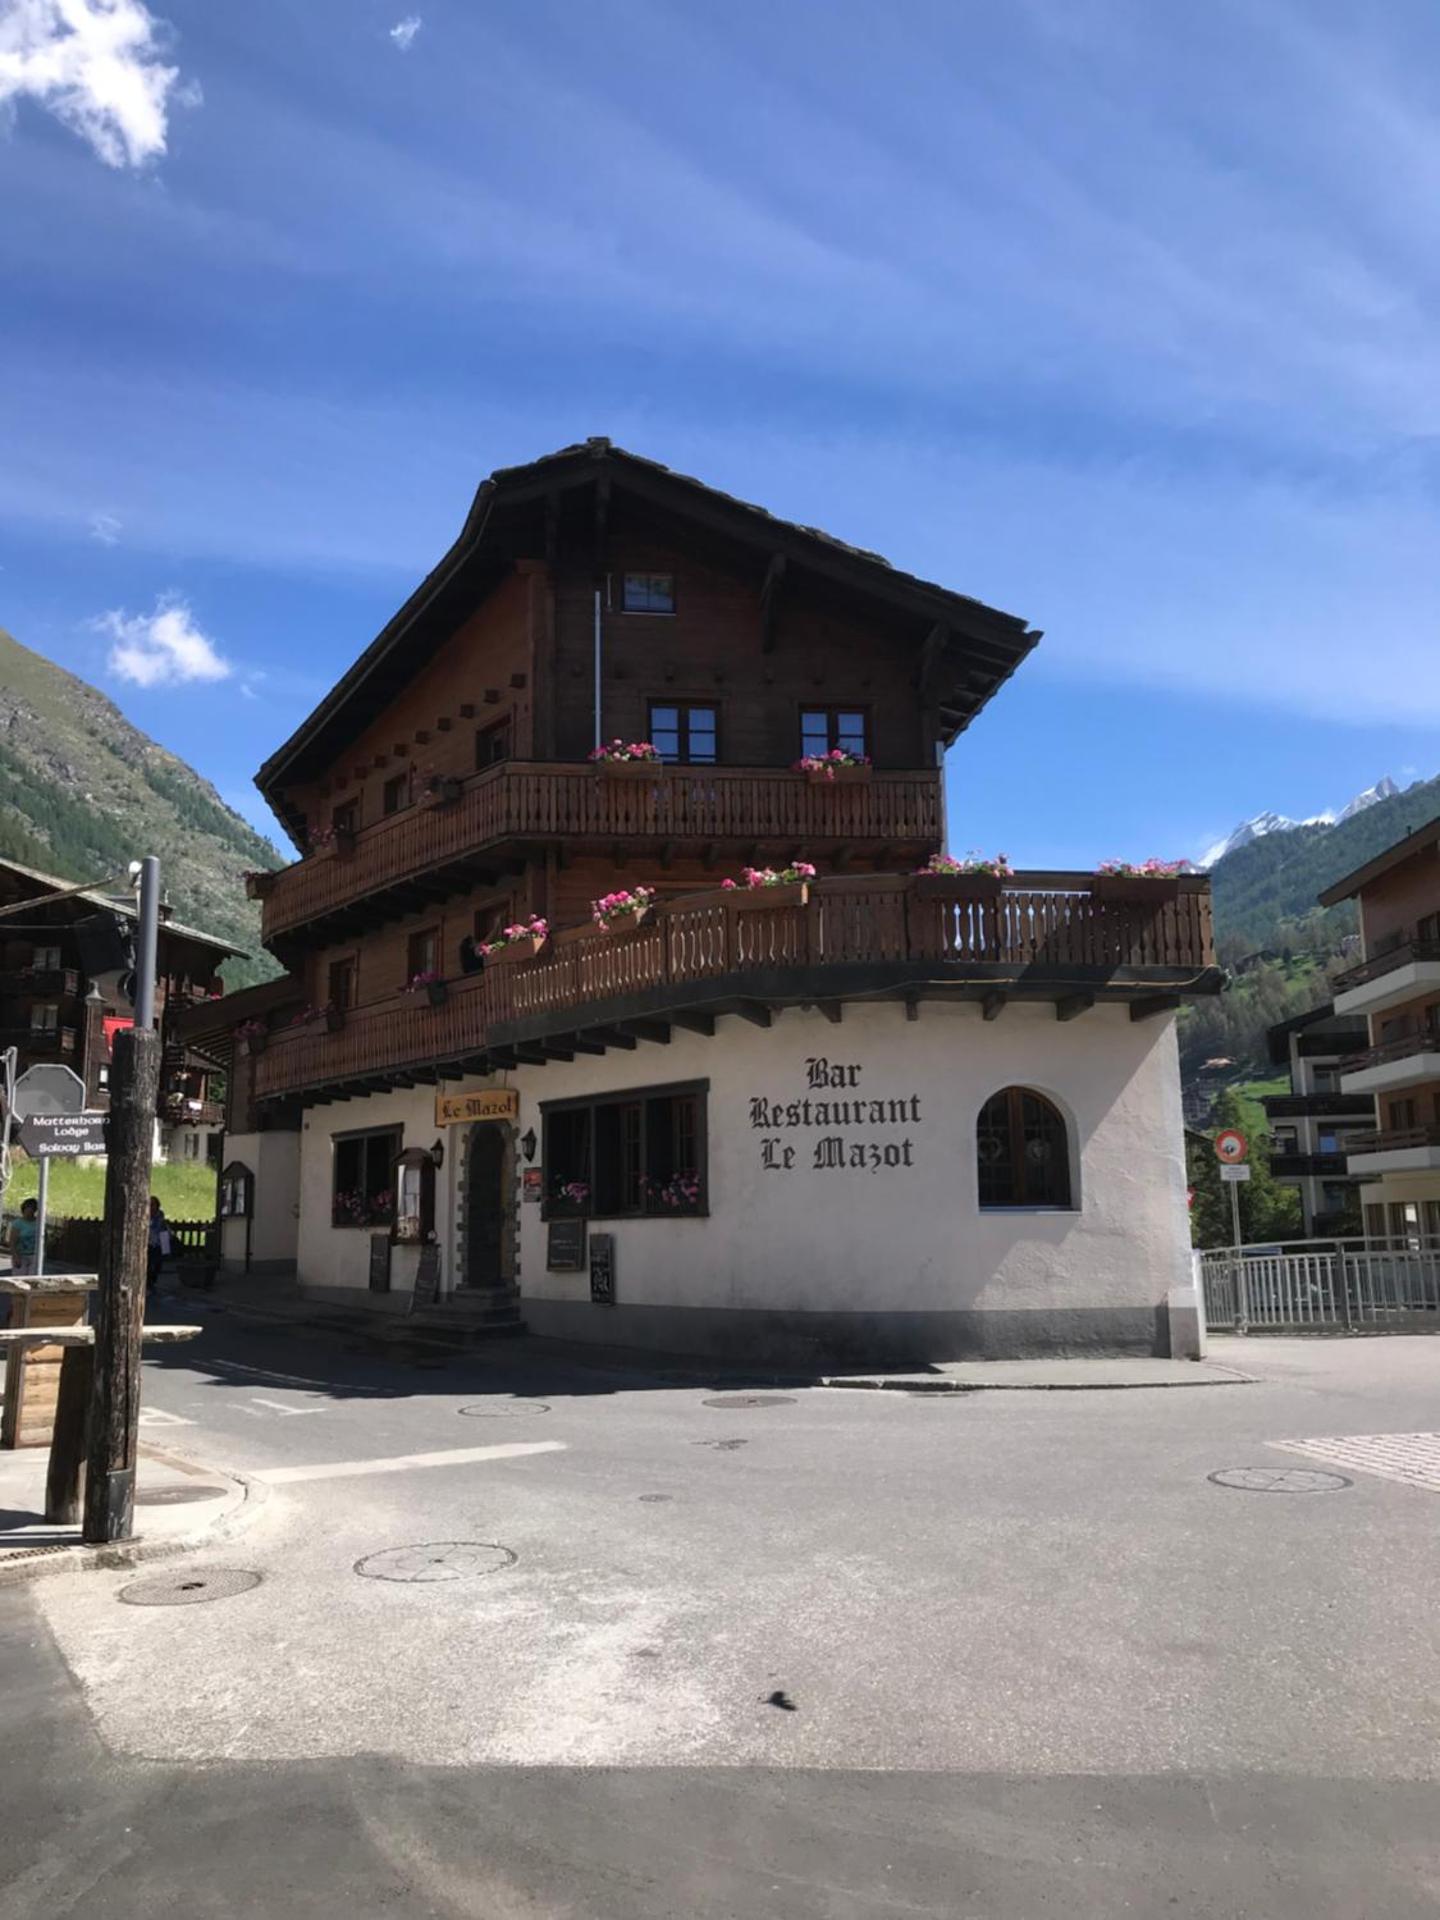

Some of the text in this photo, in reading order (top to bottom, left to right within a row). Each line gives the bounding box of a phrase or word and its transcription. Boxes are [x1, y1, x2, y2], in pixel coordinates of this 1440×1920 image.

[805, 1057, 862, 1089] Bar
[442, 1095, 513, 1118] Le Mazot
[749, 1093, 922, 1128] Restaurant
[32, 1115, 110, 1126] Matterhorn
[54, 1127, 89, 1138] Lodge
[38, 1141, 106, 1153] Solvay Bar
[761, 1136, 913, 1175] Le Mazot
